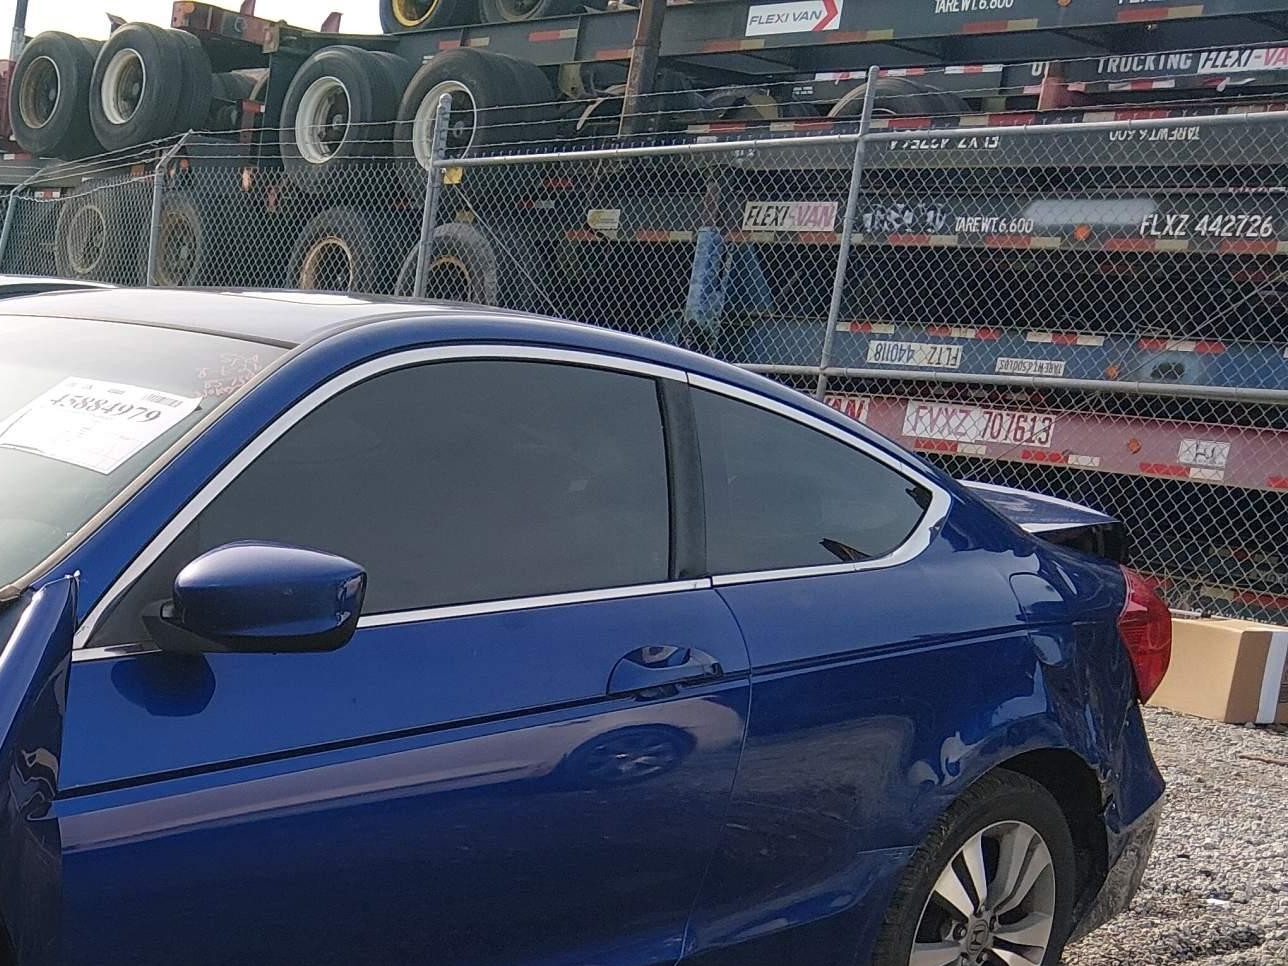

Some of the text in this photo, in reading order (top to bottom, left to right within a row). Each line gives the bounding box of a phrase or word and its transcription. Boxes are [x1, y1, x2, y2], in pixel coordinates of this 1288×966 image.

[749, 9, 824, 26] FLEXI VAN
[1097, 52, 1193, 74] TRUCKING
[1139, 214, 1274, 238] FLXZ 442726
[874, 342, 915, 362] 440118
[50, 393, 162, 423] 45884979
[982, 410, 1053, 445] 707613
